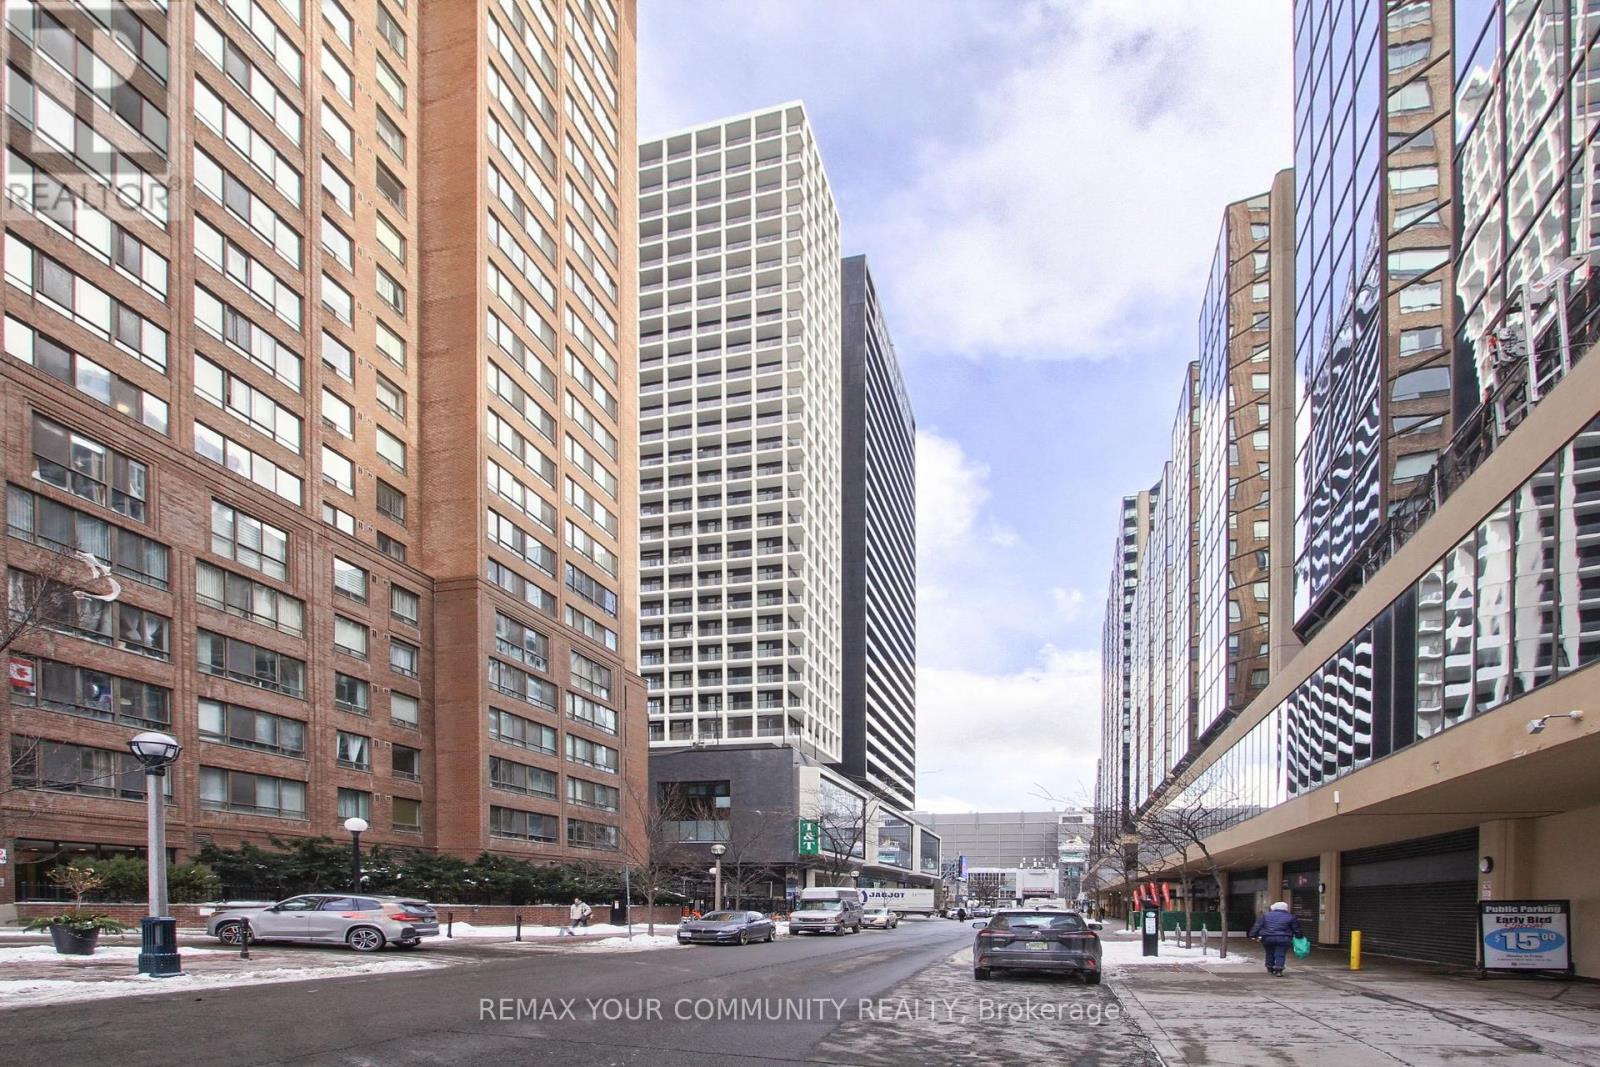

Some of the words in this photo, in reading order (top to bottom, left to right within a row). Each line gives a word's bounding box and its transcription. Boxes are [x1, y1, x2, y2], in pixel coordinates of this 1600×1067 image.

[803, 822, 816, 850] T&T
[1520, 905, 1561, 914] Parking
[1496, 916, 1525, 924] Early
[1527, 916, 1552, 924] Bird
